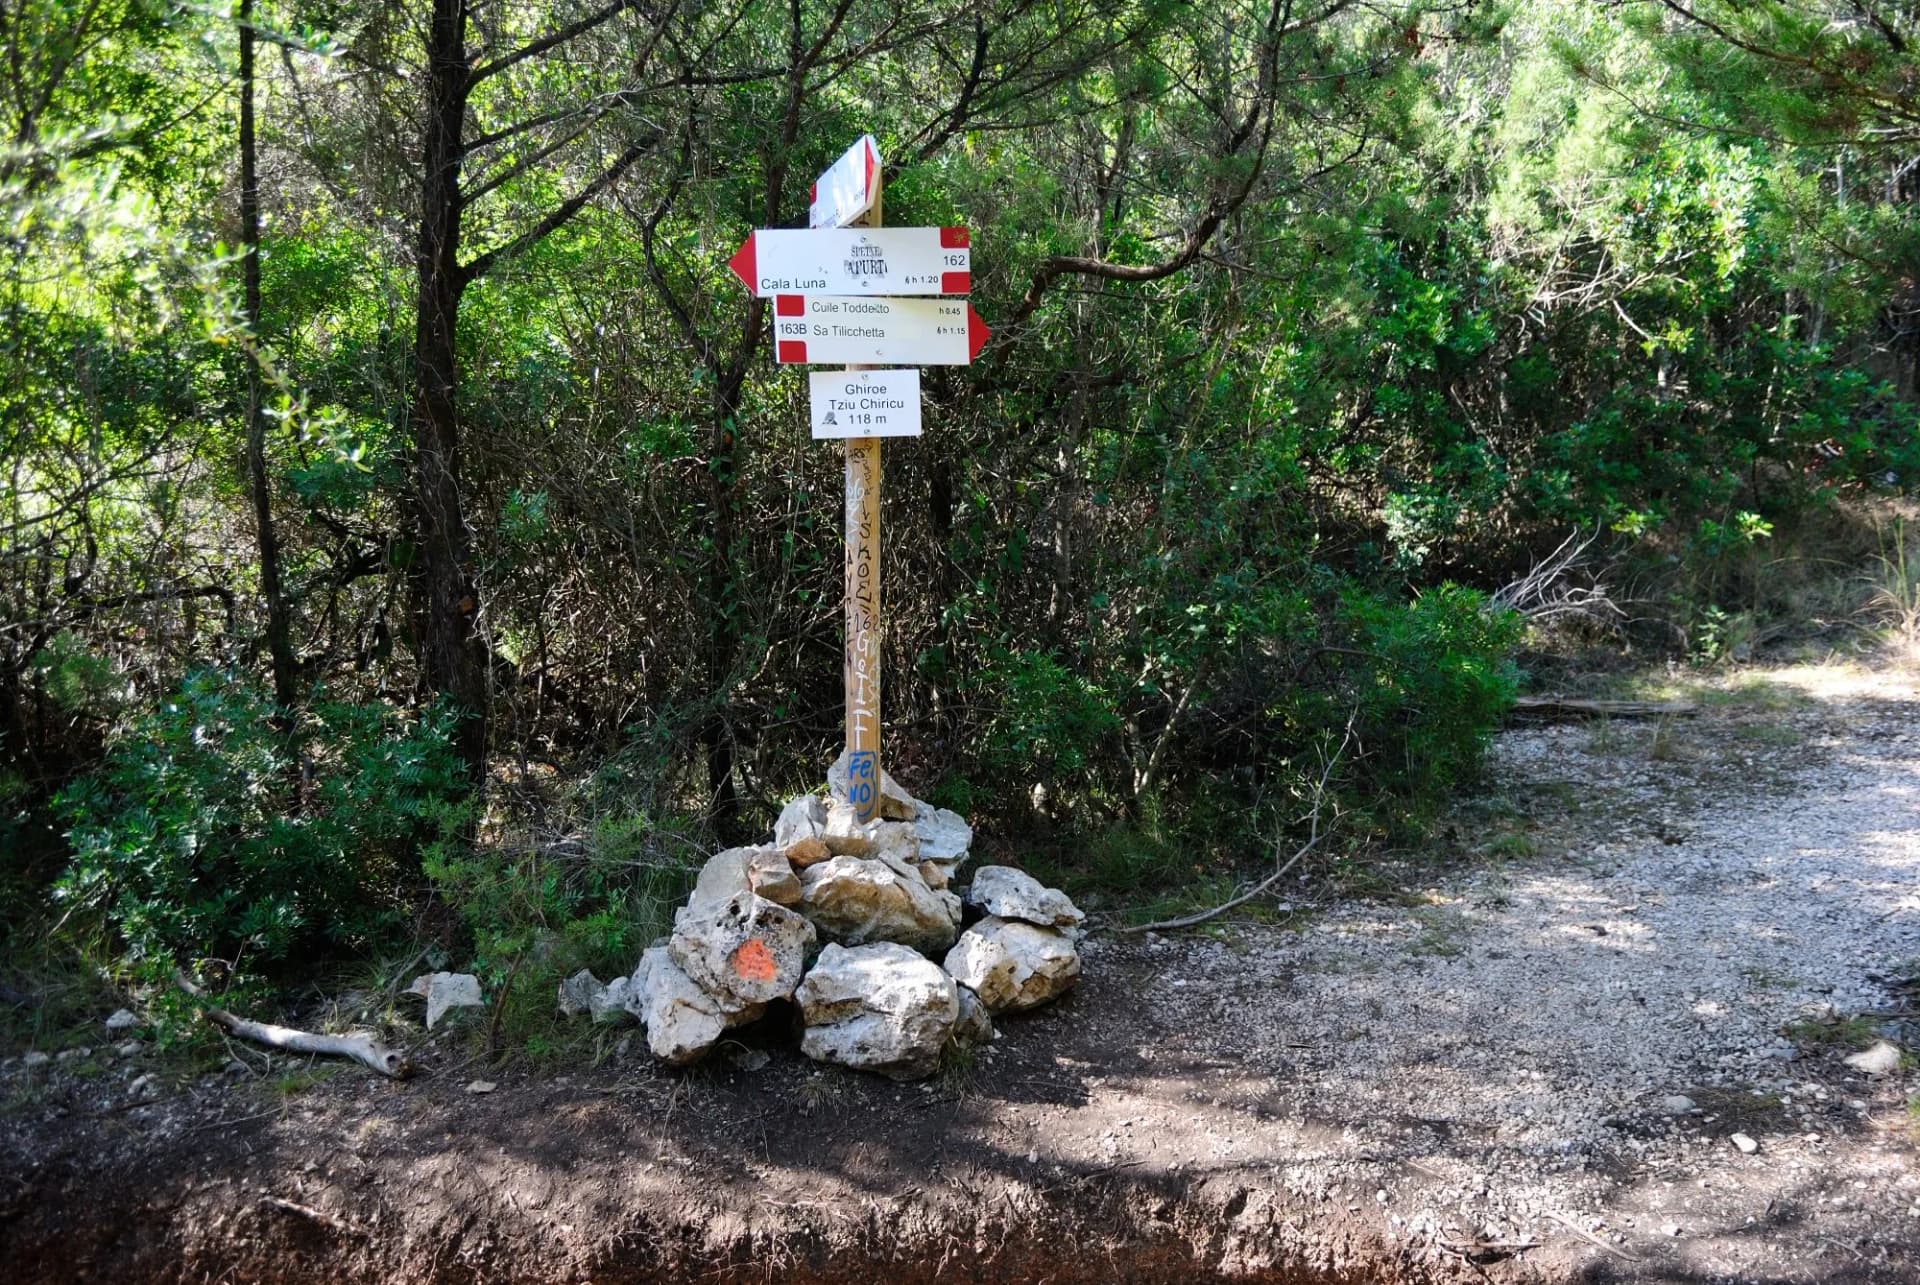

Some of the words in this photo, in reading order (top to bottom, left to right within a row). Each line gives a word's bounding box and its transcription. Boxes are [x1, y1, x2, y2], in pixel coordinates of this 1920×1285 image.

[943, 254, 966, 266] 162
[761, 278, 790, 290] Cala
[795, 278, 826, 290] Luna
[921, 276, 939, 284] 1.20
[812, 301, 839, 313] Cuile
[780, 323, 807, 335] 163B
[813, 324, 828, 336] Sa
[832, 325, 885, 338] Tilicchetta
[845, 384, 887, 396] Ghiroe
[829, 399, 856, 410] Tziu
[860, 398, 904, 410] Chiricu
[849, 414, 871, 424] 118
[876, 415, 887, 424] m
